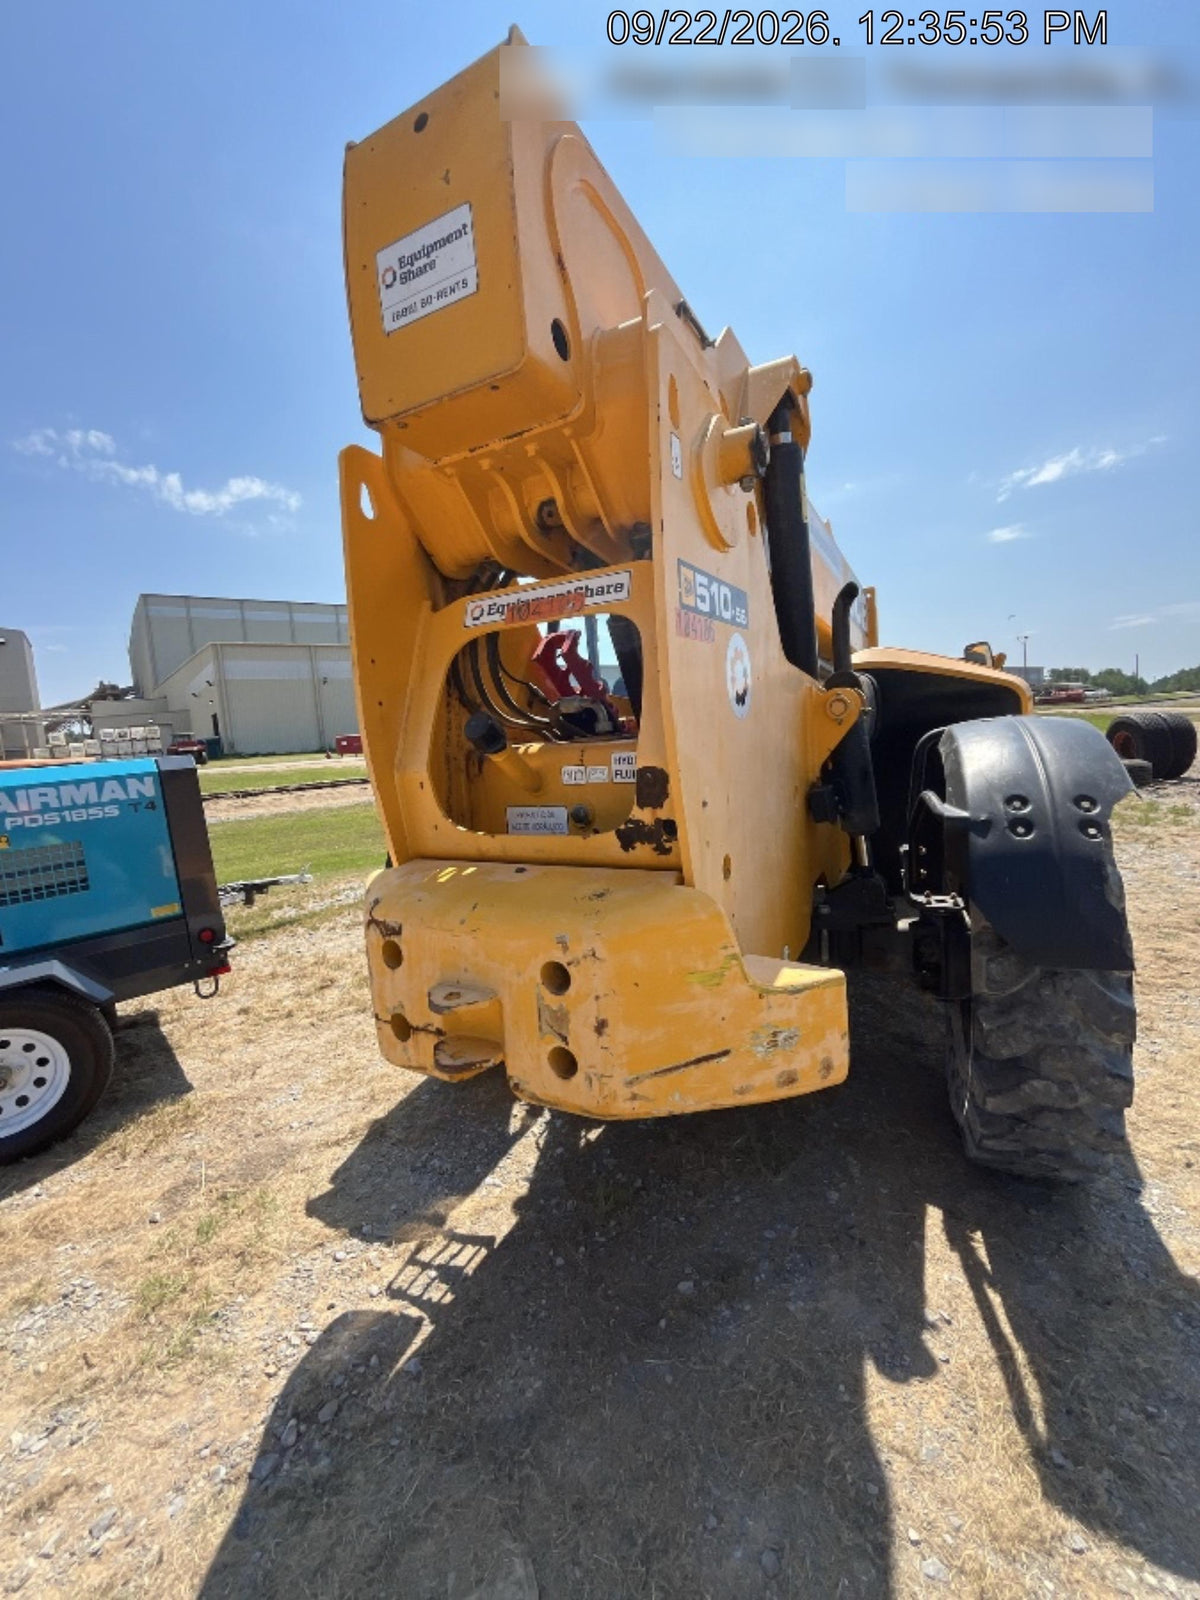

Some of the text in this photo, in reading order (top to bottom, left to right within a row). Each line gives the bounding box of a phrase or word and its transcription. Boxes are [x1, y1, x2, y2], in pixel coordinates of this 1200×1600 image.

[397, 222, 468, 271] Equipment
[399, 258, 437, 286] Share
[613, 755, 637, 766] HYD
[614, 769, 636, 780] FLUI
[0, 776, 156, 814] AIRMAN
